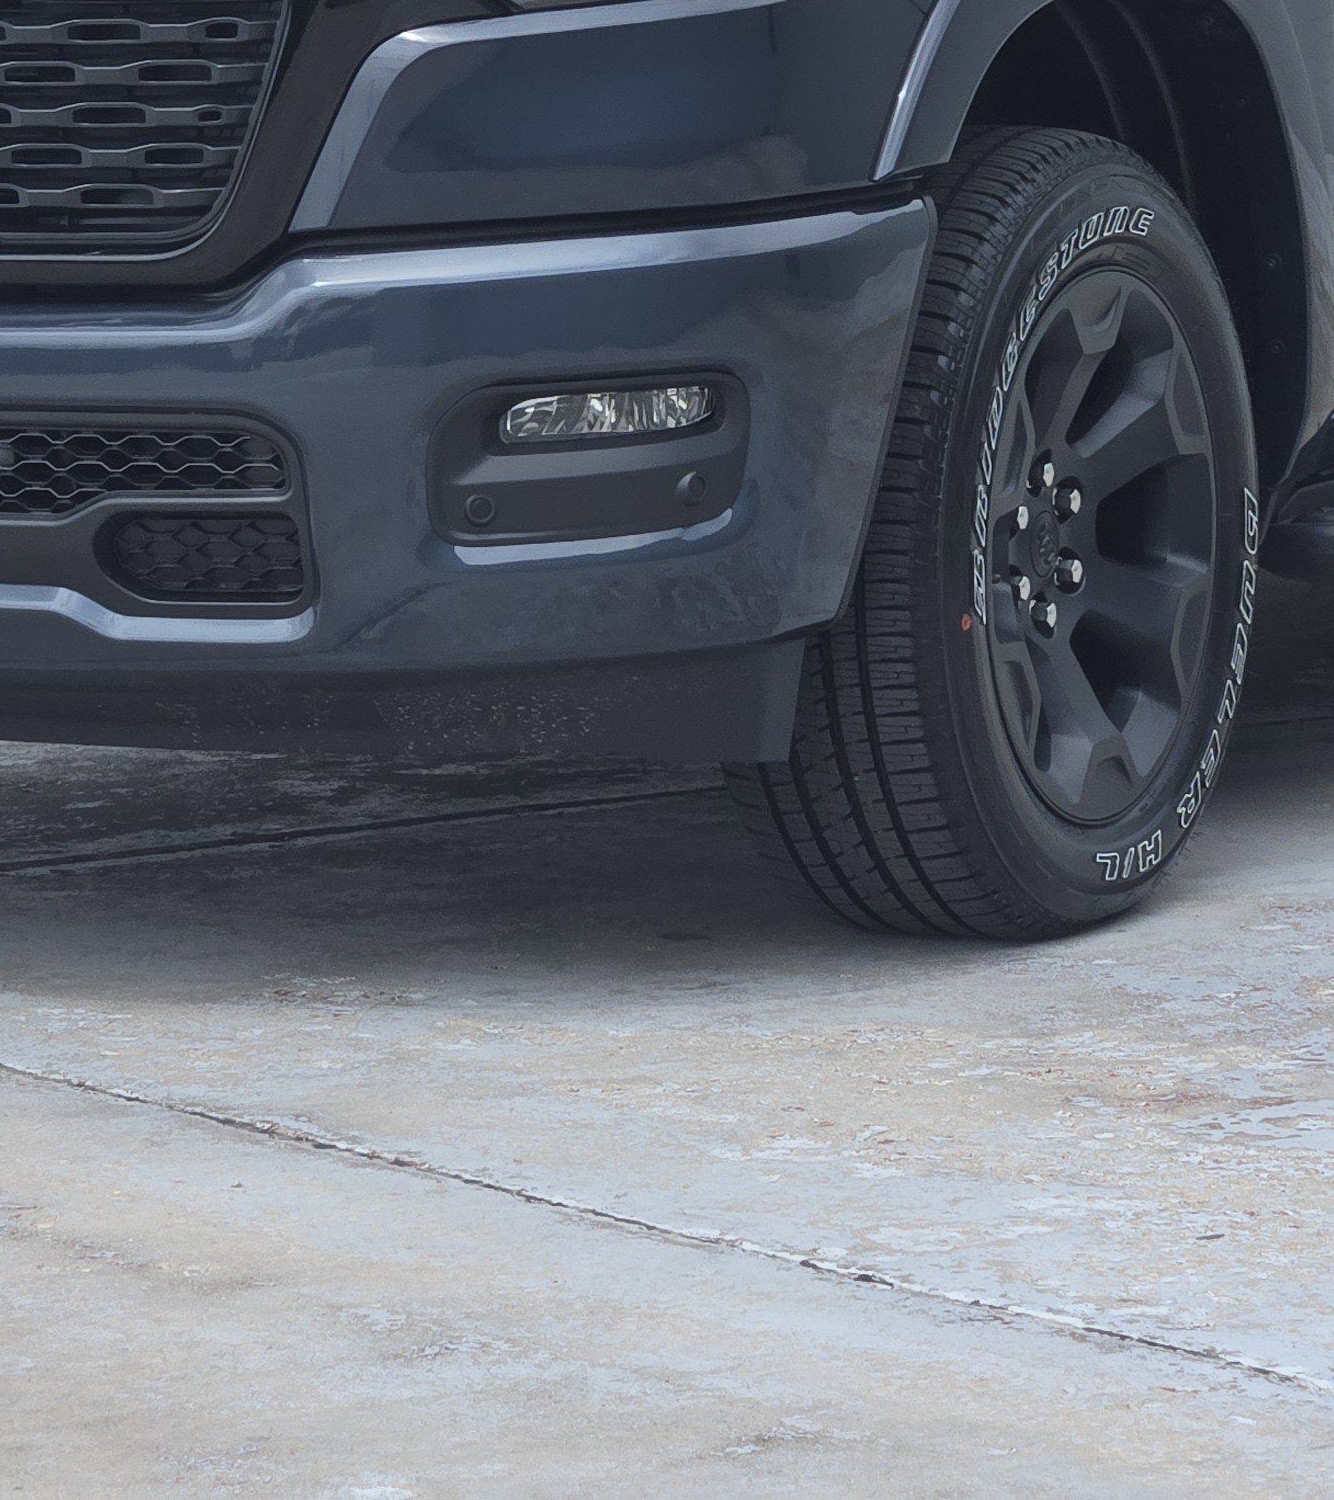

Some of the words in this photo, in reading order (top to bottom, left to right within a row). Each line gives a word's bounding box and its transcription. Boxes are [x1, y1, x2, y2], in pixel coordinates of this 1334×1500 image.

[971, 206, 1155, 626] BRIDGESTONE
[1177, 486, 1259, 829] DUELER
[1095, 829, 1164, 881] H/L
